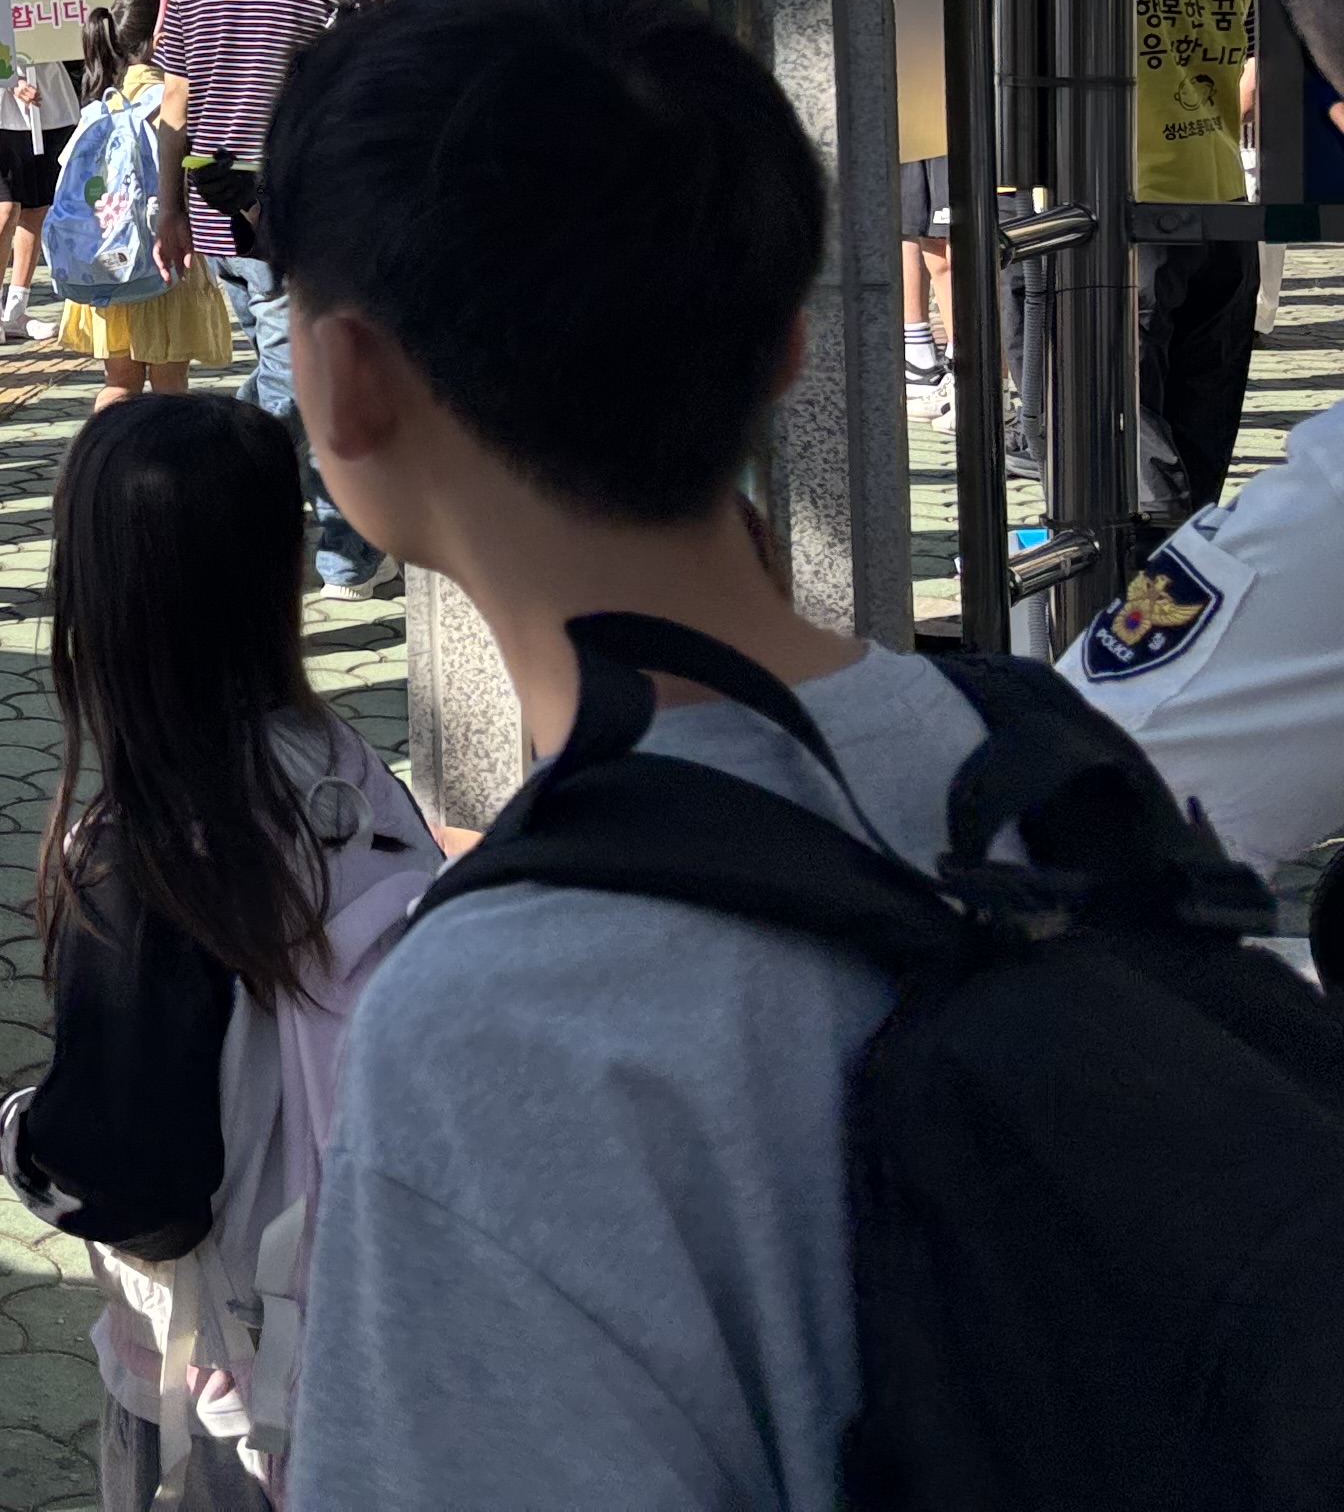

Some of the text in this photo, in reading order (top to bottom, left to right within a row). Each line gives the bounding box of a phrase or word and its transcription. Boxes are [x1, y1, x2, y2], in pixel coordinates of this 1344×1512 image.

[11, 0, 88, 29] 합니다
[1139, 33, 1246, 69] 응합니다
[1096, 628, 1134, 663] POLICE
